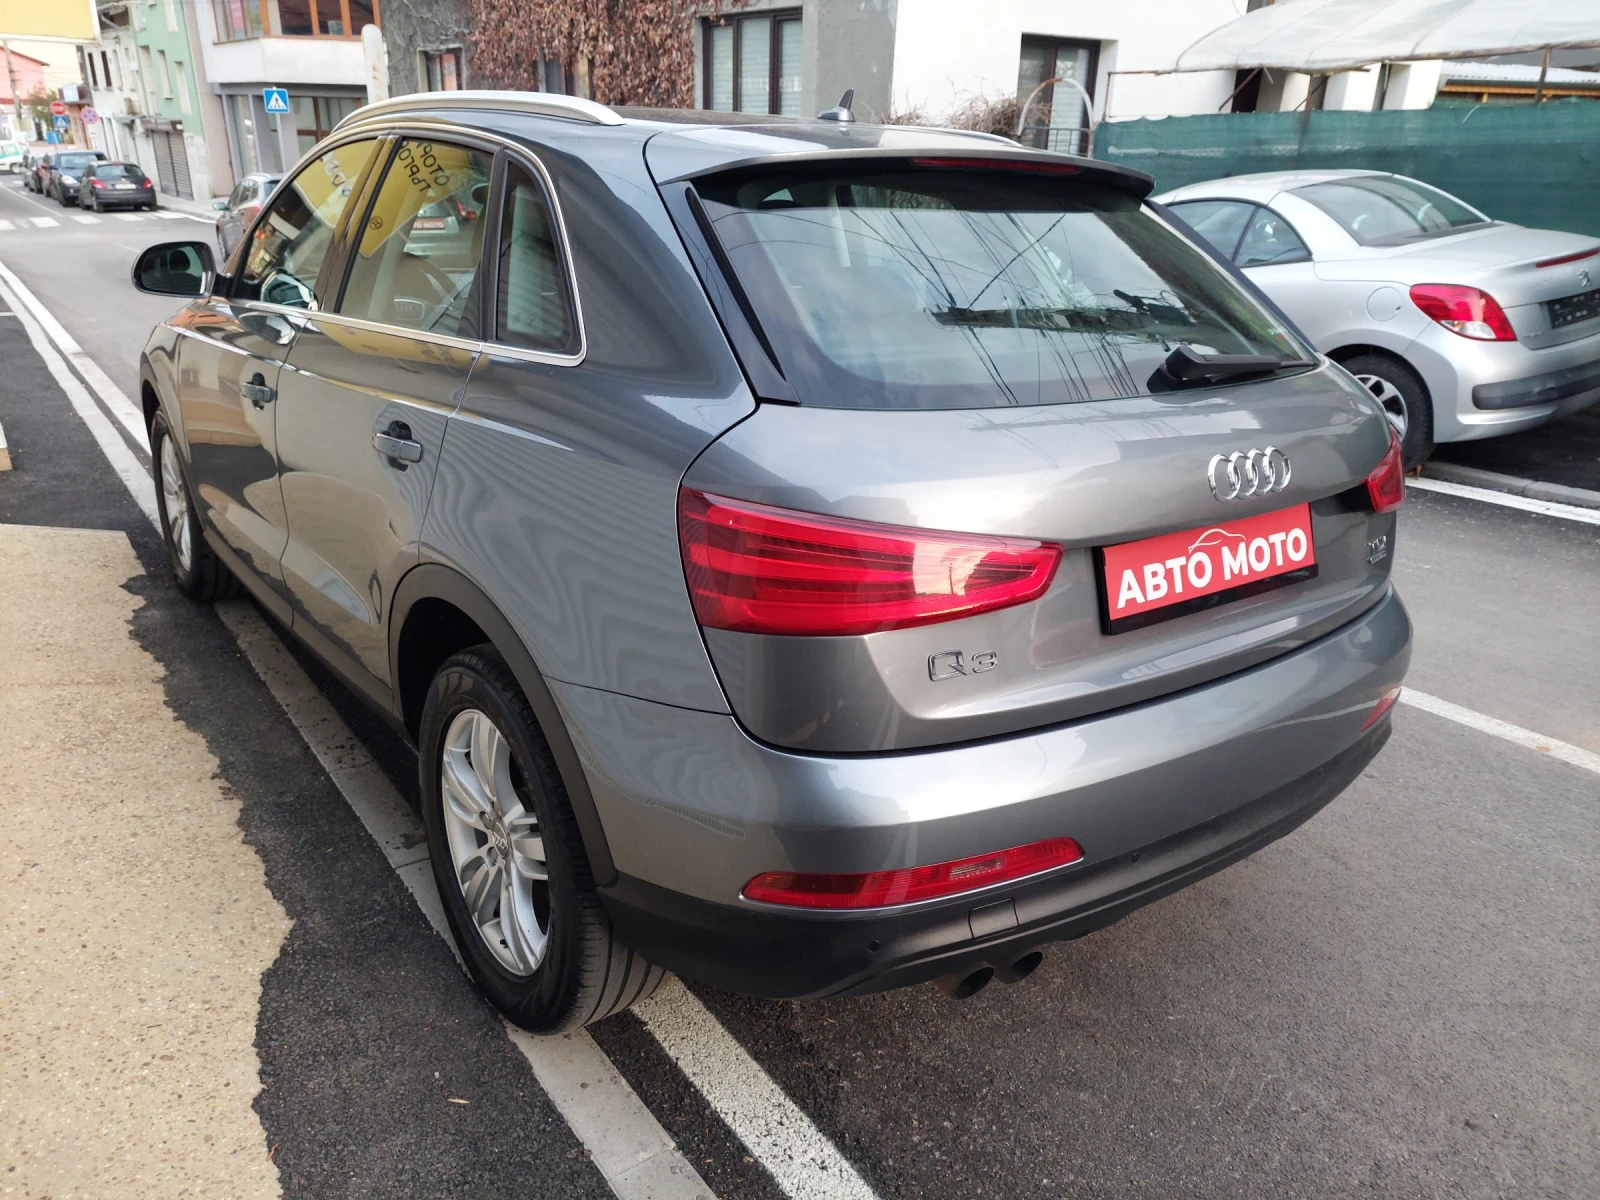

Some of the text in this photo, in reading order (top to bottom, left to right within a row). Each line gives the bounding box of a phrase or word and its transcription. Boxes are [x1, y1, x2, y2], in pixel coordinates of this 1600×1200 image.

[1117, 527, 1308, 609] АВТО МОТО
[927, 648, 998, 682] Q3
